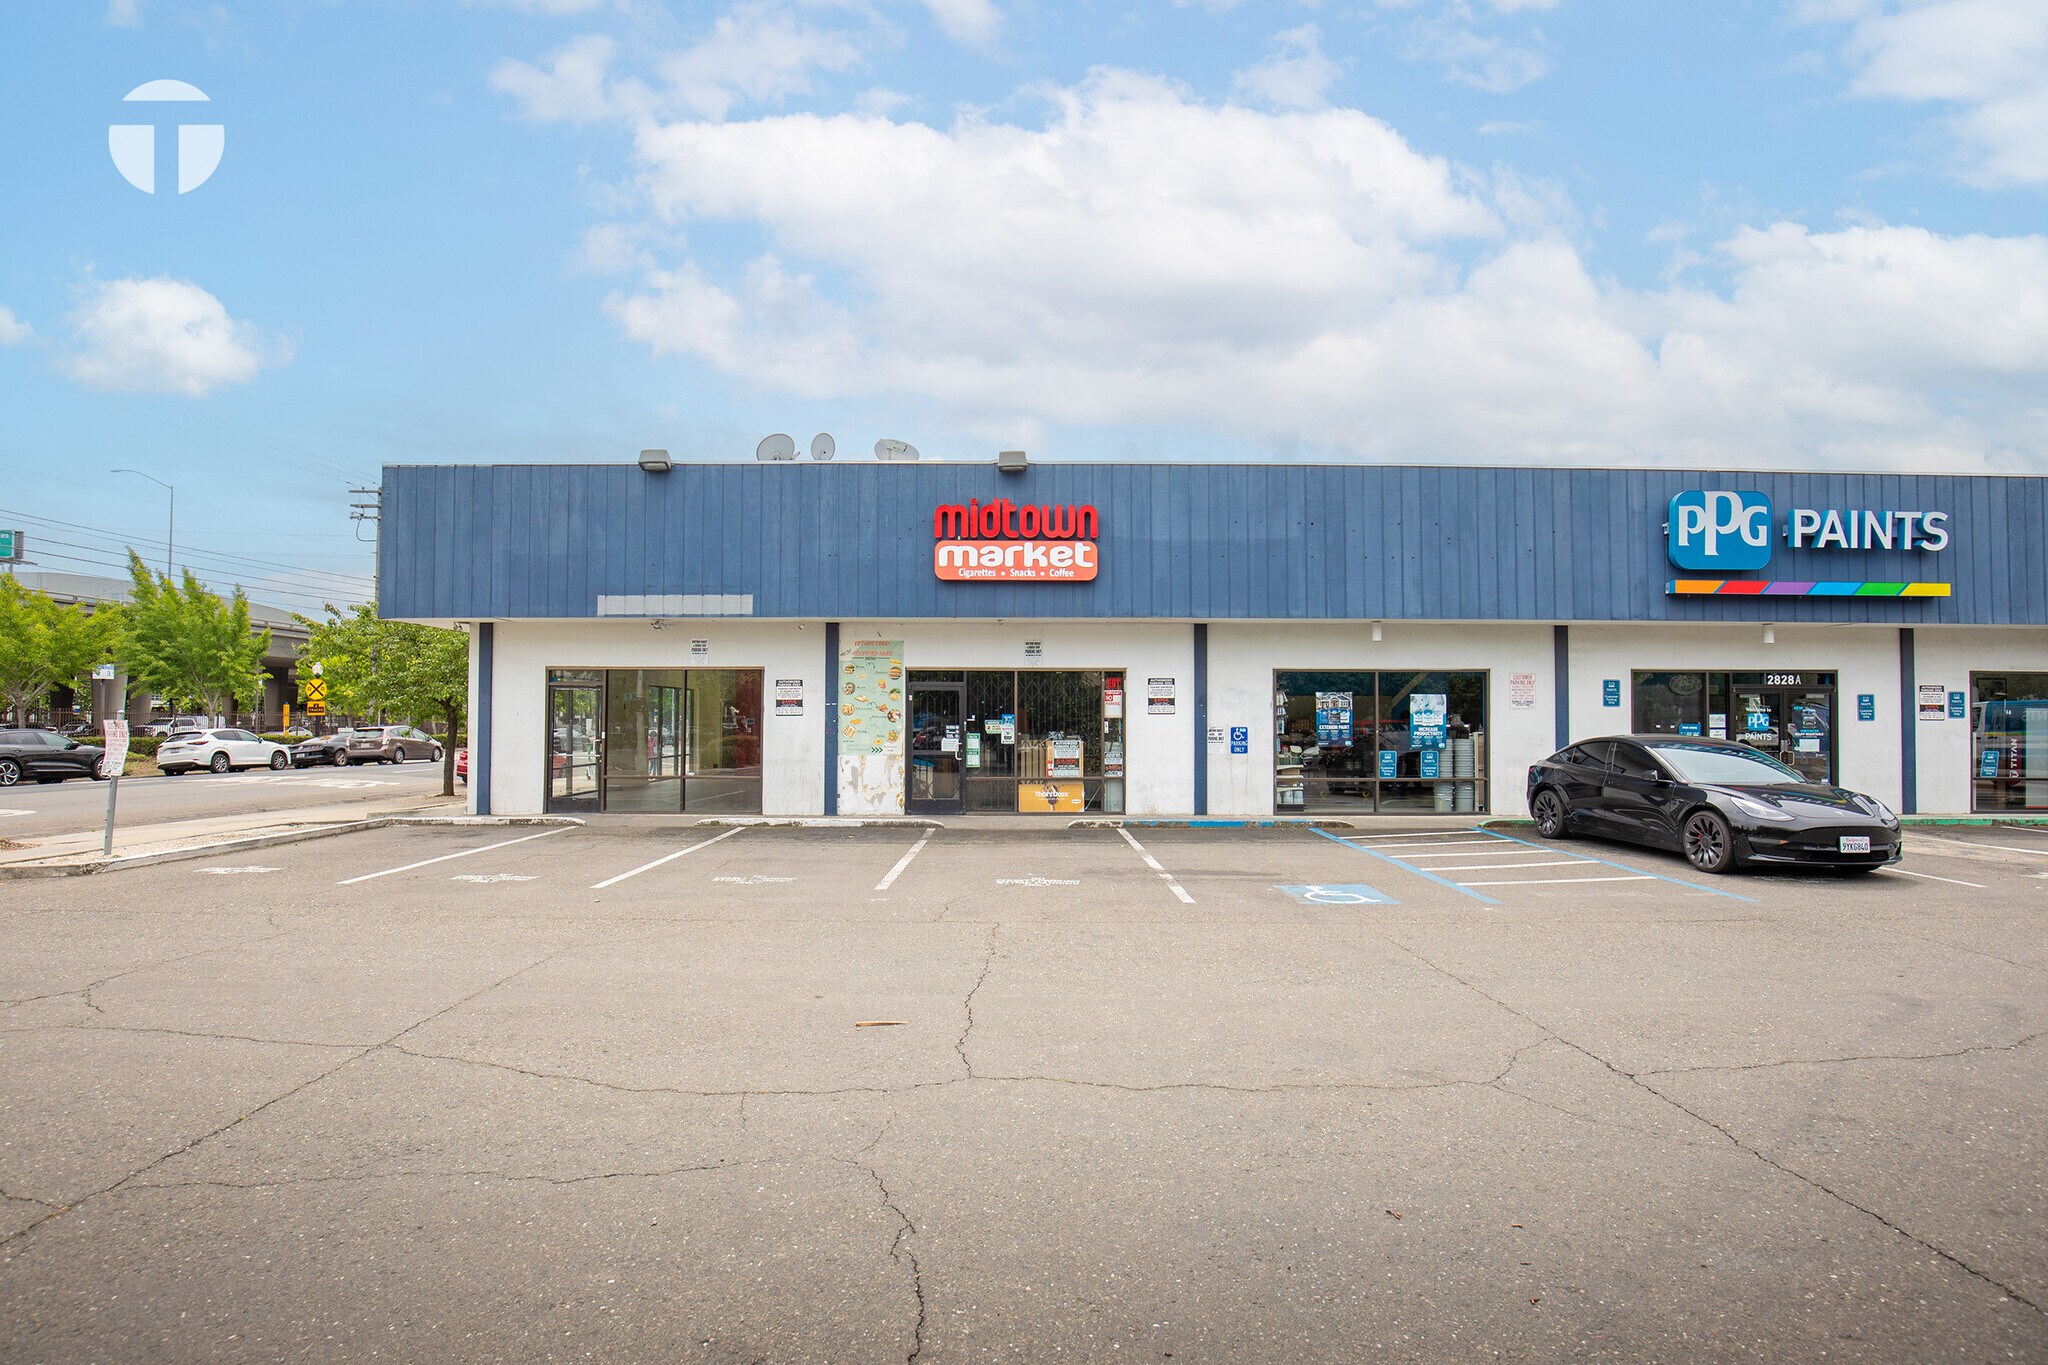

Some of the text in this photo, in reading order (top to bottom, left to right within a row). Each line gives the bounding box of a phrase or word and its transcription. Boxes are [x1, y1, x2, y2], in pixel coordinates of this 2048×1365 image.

[934, 498, 1099, 539] midtown
[1678, 491, 1768, 556] PPG
[1790, 509, 1949, 551] PAINTS
[938, 542, 1094, 568] market
[958, 568, 1075, 578] Cigarettes Snacks Coffee
[1106, 677, 1121, 689] EBT
[1767, 675, 1802, 685] 2828A
[1748, 713, 1769, 728] PPG
[1745, 733, 1772, 741] PAINTS
